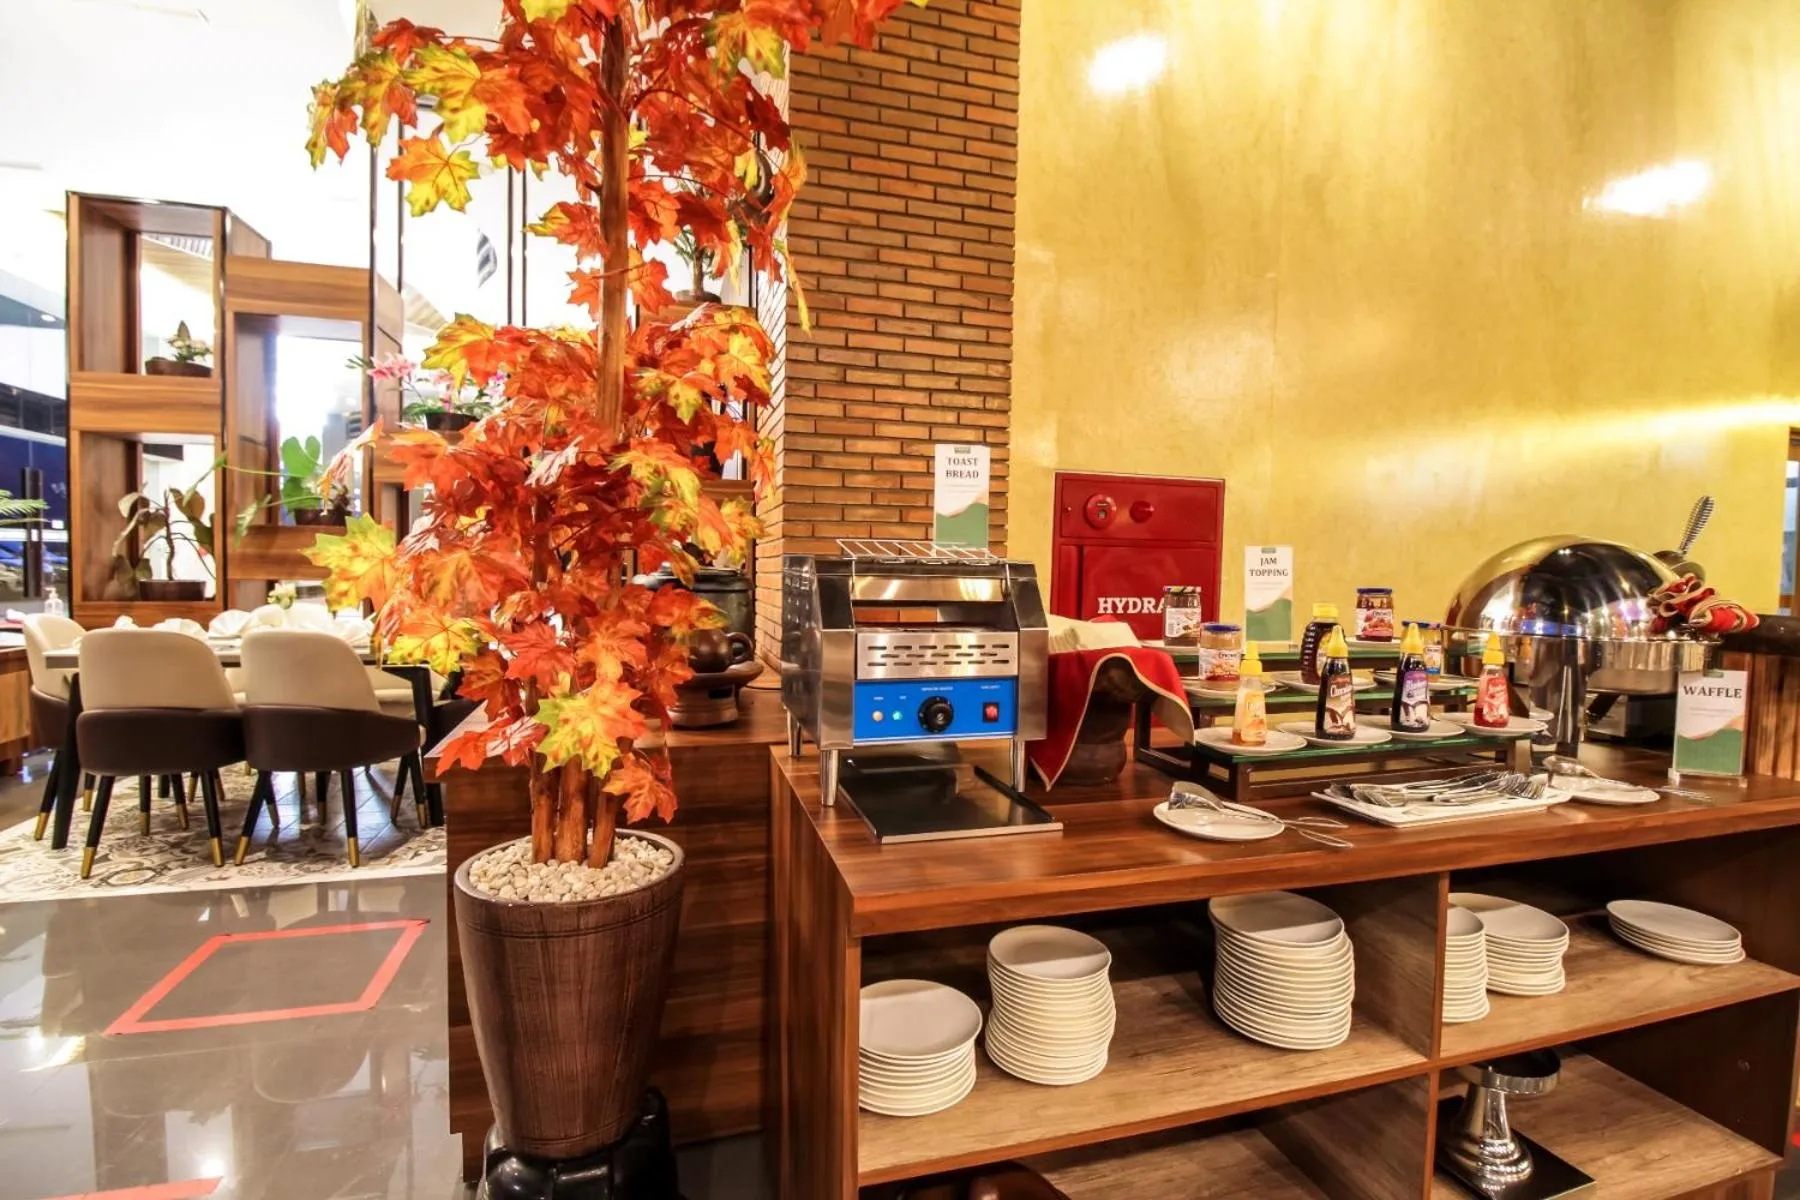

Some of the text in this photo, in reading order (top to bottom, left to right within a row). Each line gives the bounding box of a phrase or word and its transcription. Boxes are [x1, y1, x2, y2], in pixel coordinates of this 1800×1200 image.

[945, 457, 979, 466] TOAST
[945, 469, 980, 479] BREAD
[1260, 557, 1278, 567] JAM
[1249, 568, 1289, 577] TOPPING
[1683, 685, 1743, 699] WAFFLE
